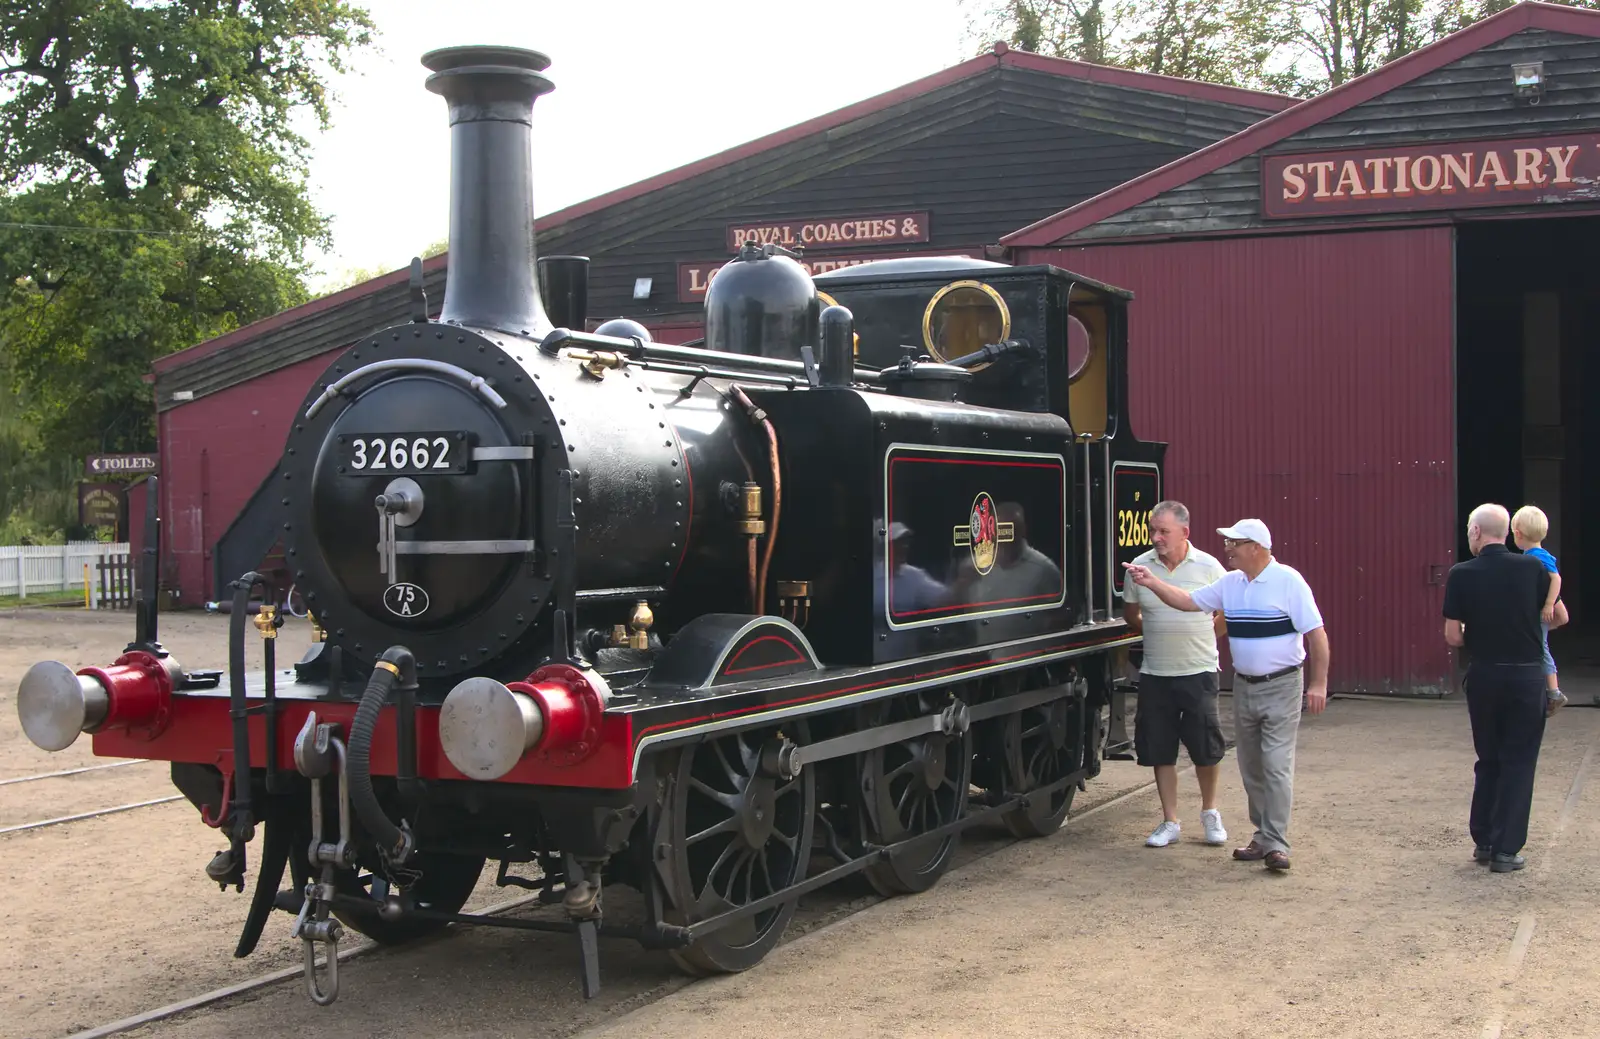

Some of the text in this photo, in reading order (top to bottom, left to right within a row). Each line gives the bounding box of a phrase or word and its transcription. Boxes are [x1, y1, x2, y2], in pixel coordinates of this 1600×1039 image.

[1282, 144, 1580, 200] STATIONARY
[734, 217, 919, 247] ROYAL COACHES &
[102, 457, 156, 469] TOILETS
[351, 436, 451, 470] 32662
[395, 586, 416, 603] 75
[401, 602, 412, 615] A
